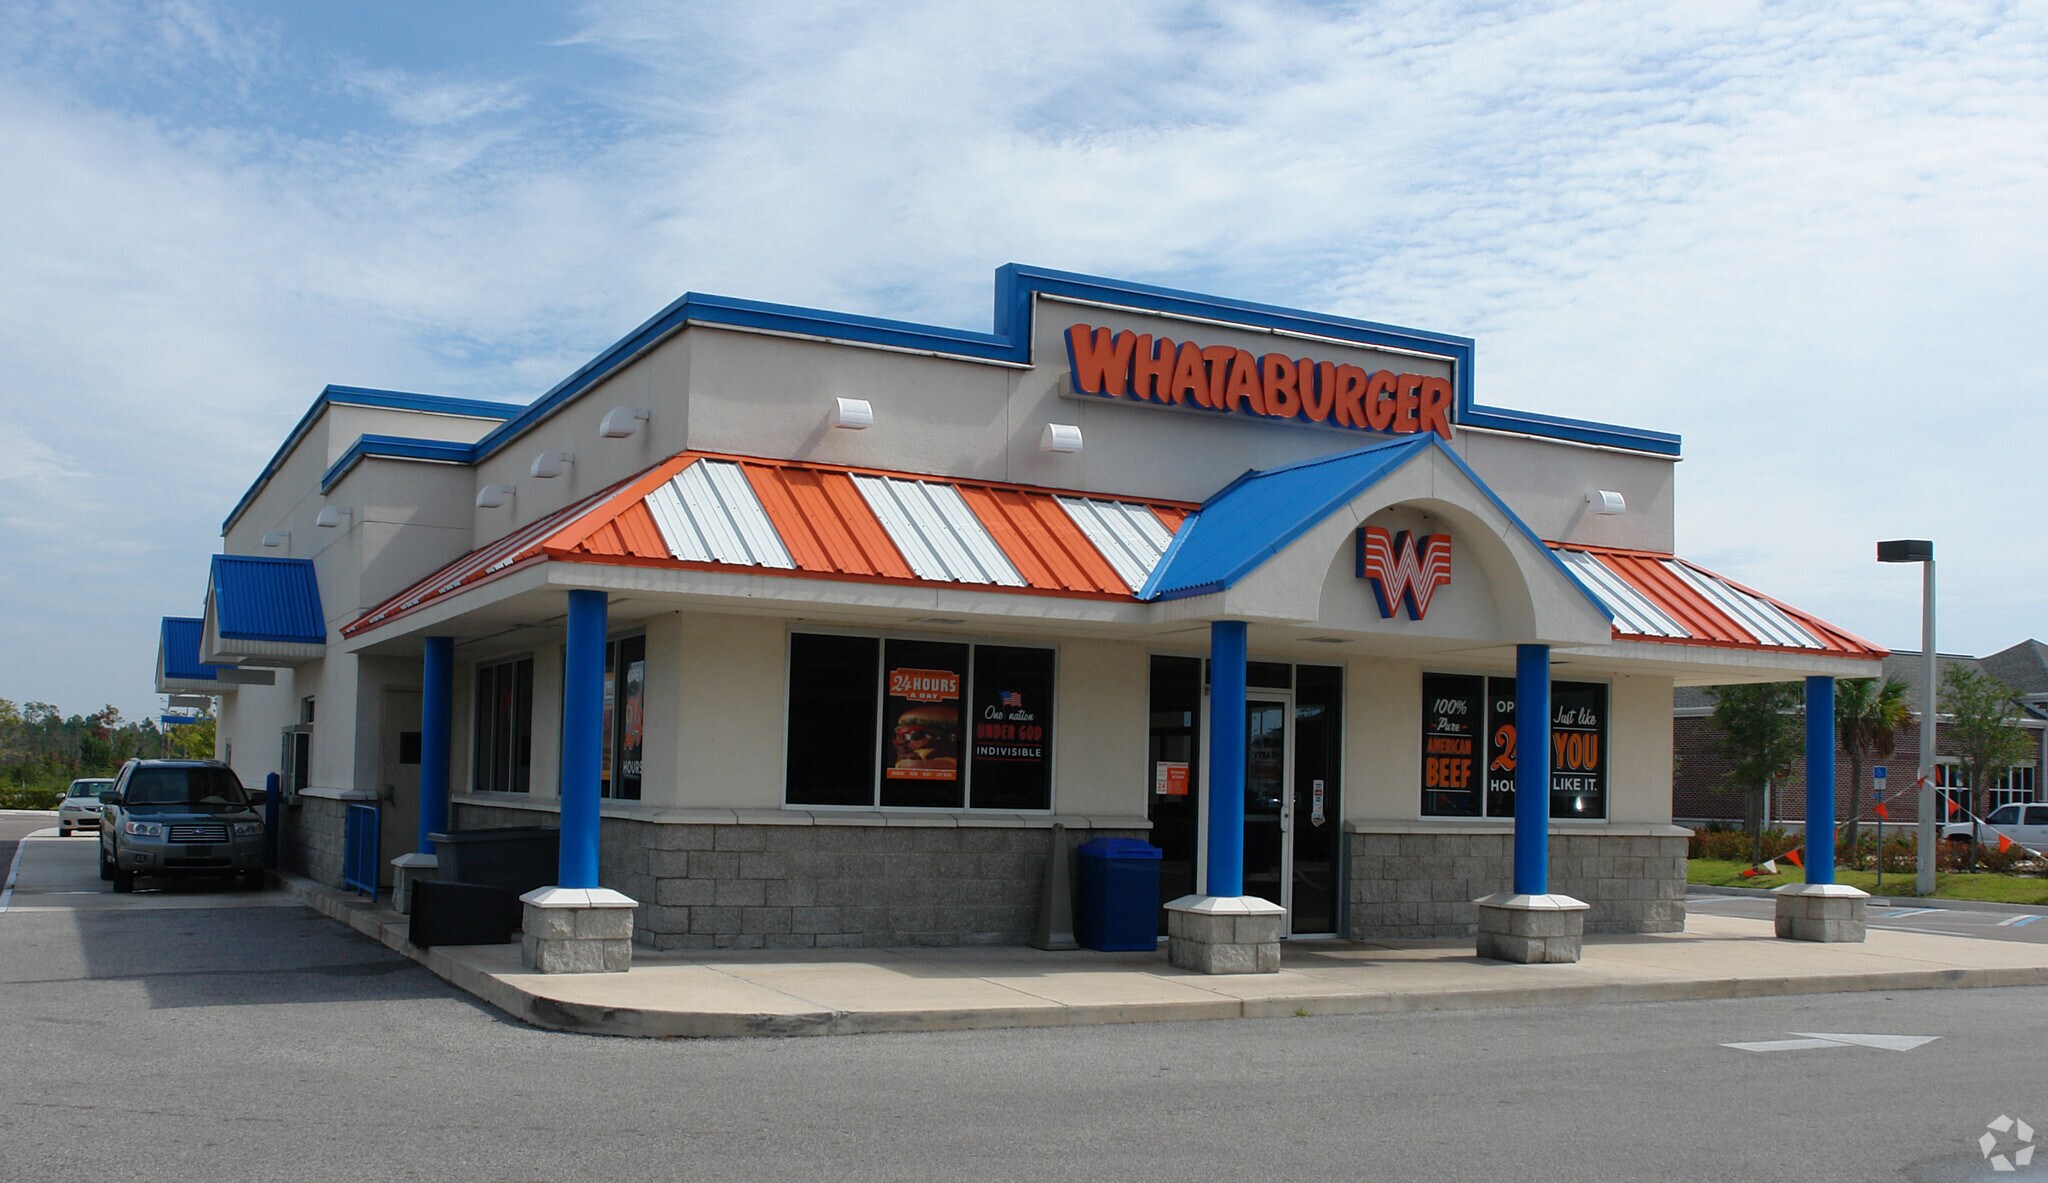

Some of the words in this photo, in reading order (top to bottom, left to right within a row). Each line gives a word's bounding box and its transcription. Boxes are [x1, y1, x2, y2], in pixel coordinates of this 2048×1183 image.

[1064, 323, 1452, 440] WHATABURGER
[1356, 526, 1452, 621] W
[891, 675, 912, 692] 24
[912, 677, 956, 693] HOURS
[984, 705, 1004, 720] One
[1009, 709, 1035, 721] nation
[1433, 698, 1467, 715] 100%
[1496, 700, 1515, 713] OP
[1553, 705, 1576, 724] Just
[1578, 707, 1596, 726] like
[977, 724, 1015, 740] UNDER
[1018, 725, 1043, 740] GOD
[1436, 717, 1461, 732] Pure
[976, 746, 1042, 758] INDIVISIBLE
[1427, 737, 1472, 754] AMERICAN
[1552, 732, 1599, 770] YOU
[1425, 758, 1472, 788] BEEF
[1491, 780, 1515, 791] HOU
[1553, 778, 1581, 791] LIKE
[1585, 779, 1597, 791] IT.
